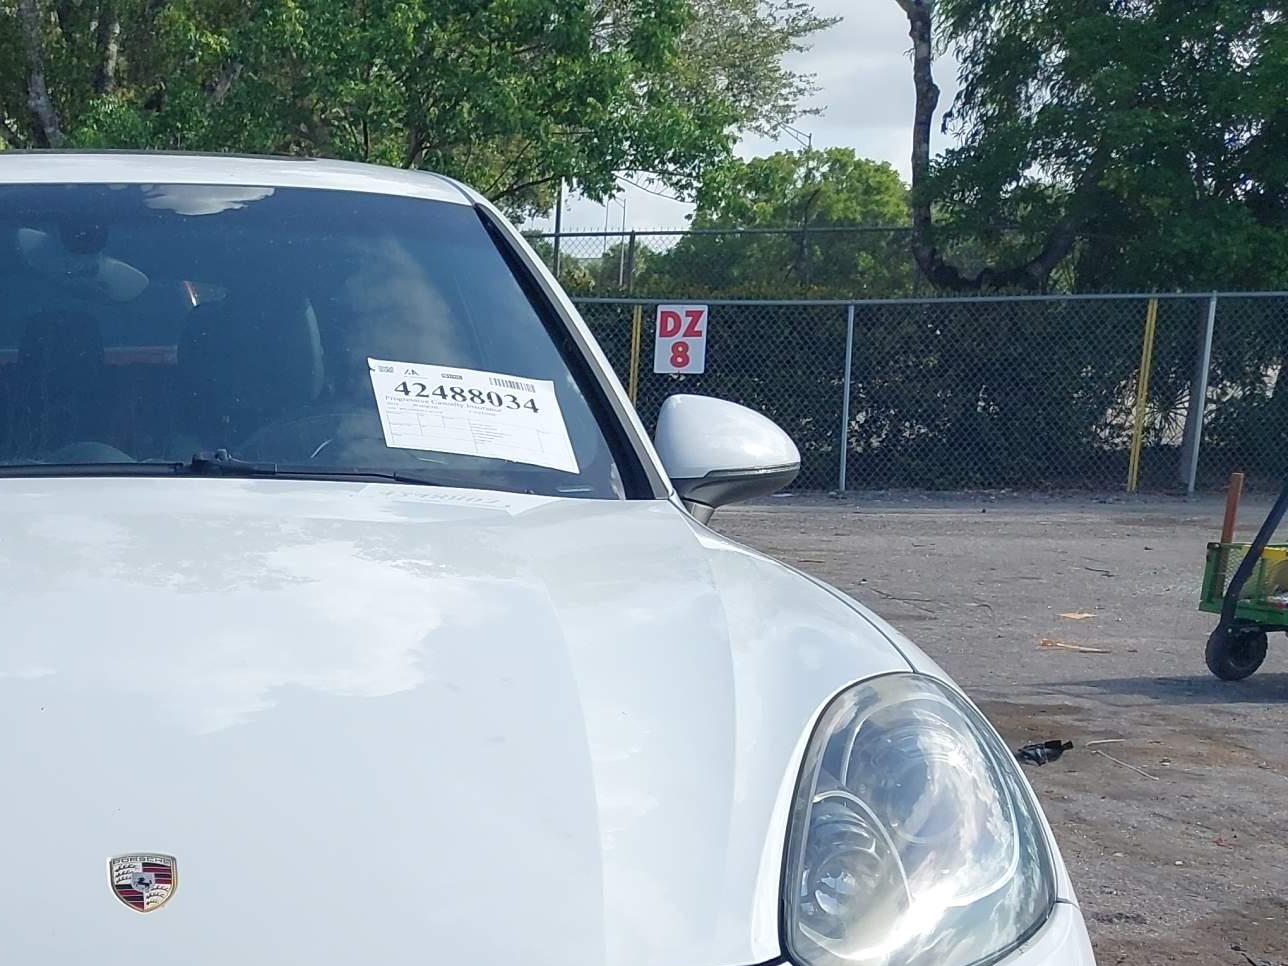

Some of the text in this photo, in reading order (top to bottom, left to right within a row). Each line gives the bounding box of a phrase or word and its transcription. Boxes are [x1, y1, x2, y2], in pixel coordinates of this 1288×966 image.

[659, 310, 705, 338] DZ
[670, 341, 690, 369] 8
[394, 381, 540, 414] 42488034
